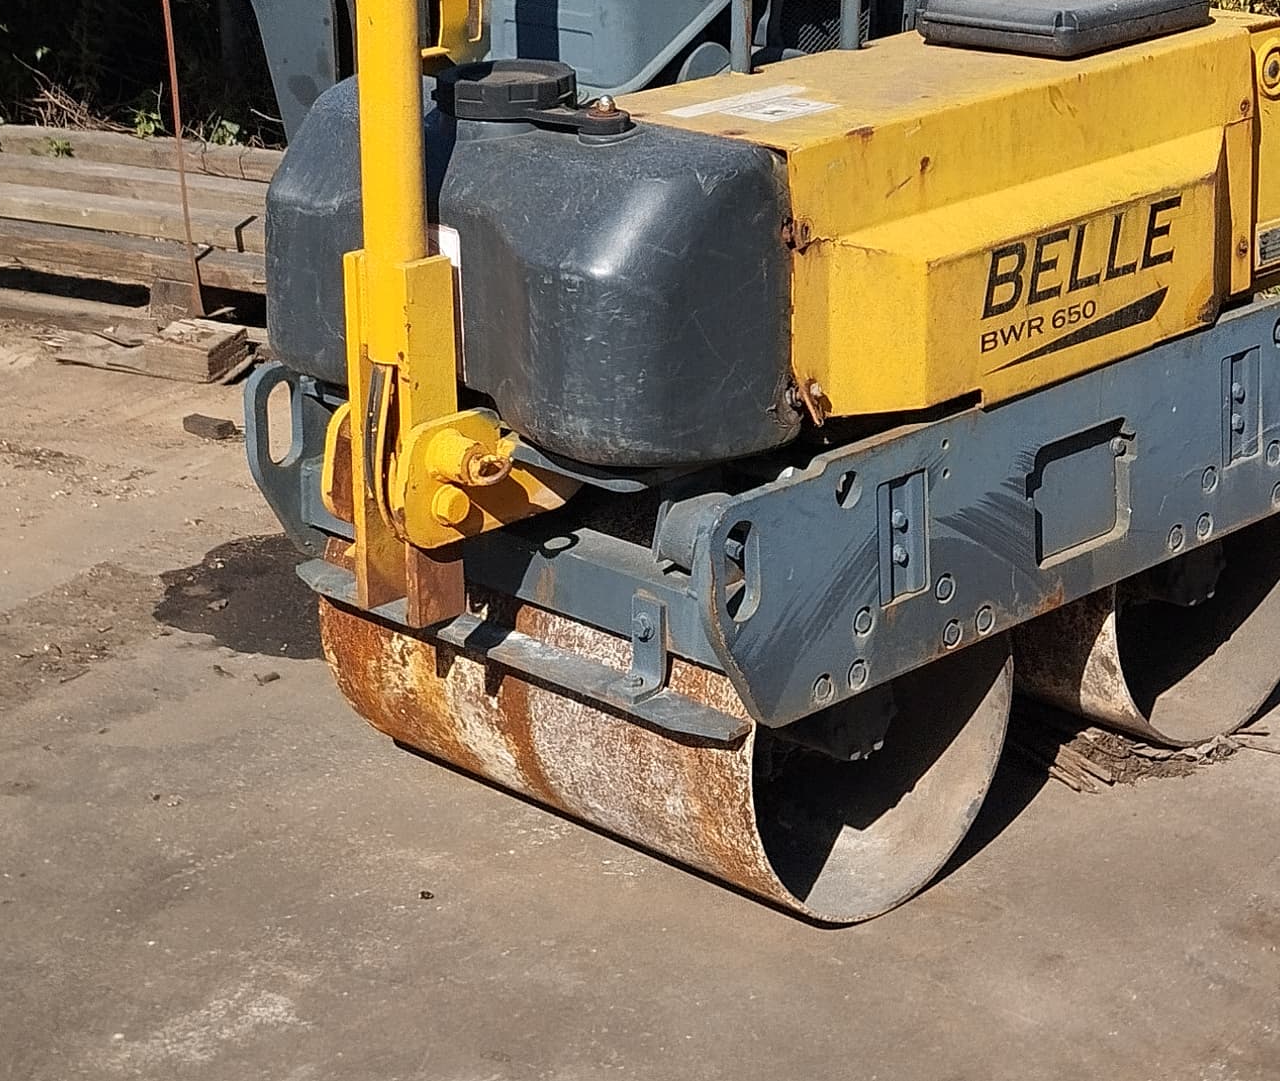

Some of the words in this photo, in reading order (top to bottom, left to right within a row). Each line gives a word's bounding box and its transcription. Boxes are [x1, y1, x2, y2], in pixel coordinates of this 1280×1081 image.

[981, 195, 1182, 321] BELLE
[981, 315, 1044, 353] BWR
[1052, 299, 1097, 330] 650
